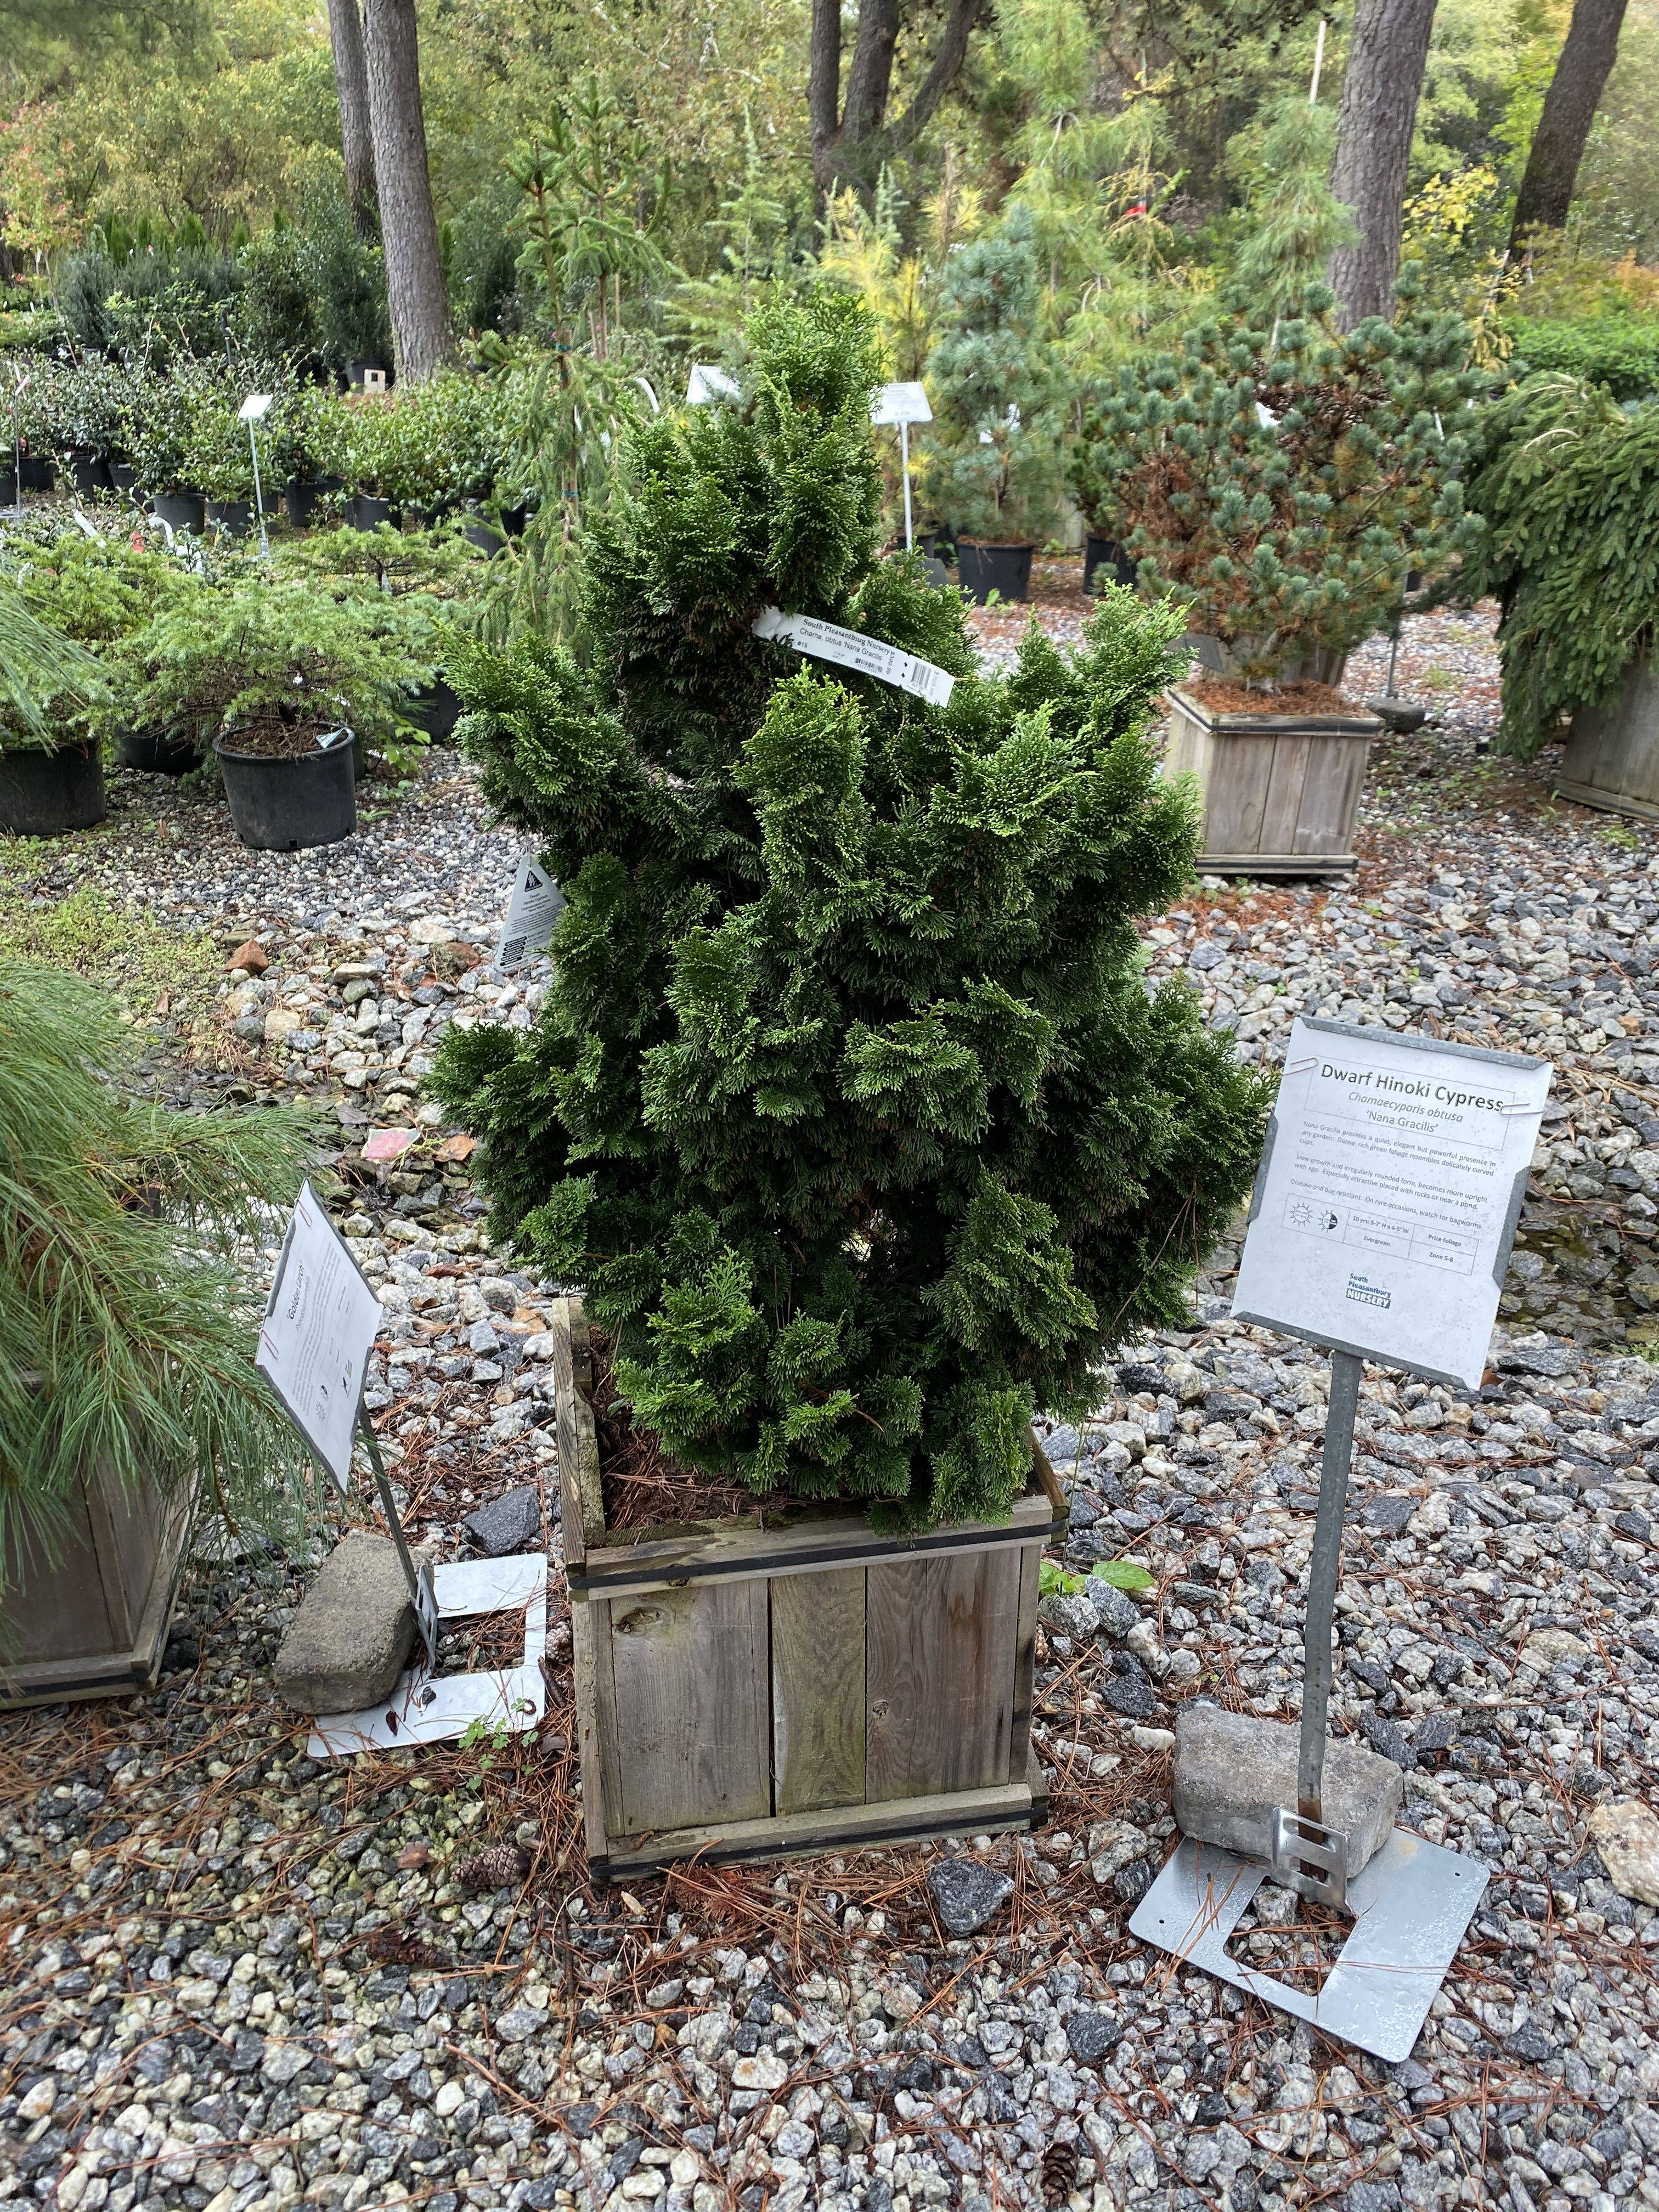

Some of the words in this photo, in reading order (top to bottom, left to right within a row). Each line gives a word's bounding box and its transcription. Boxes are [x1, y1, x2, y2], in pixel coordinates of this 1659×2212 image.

[803, 618, 823, 630] South
[825, 625, 866, 646] Pleasantburg
[867, 639, 890, 656] Nursery
[825, 636, 842, 646] obtus
[1321, 1064, 1373, 1085] Dwarf
[1375, 1074, 1430, 1097] Hinoki
[1435, 1086, 1503, 1111] Cypress
[1348, 1092, 1425, 1114] Chamaecyparis
[1427, 1108, 1463, 1122] obtusa
[1303, 1120, 1318, 1128] Nana
[1320, 1125, 1340, 1133] Gracilis
[1342, 1130, 1367, 1139] provides
[1393, 1141, 1415, 1150] elegant
[1429, 1149, 1457, 1159] powerful
[1459, 1155, 1487, 1165] presence
[1337, 1137, 1356, 1146] Dense,
[1389, 1148, 1408, 1158] foliage
[1409, 1154, 1440, 1164] resembles
[1441, 1160, 1471, 1171] delicately
[1472, 1167, 1494, 1176] curved
[1322, 1168, 1350, 1181] Especially
[1350, 1176, 1378, 1186] attractive
[1379, 1182, 1399, 1191] placed
[1344, 1166, 1373, 1177] irregularly
[1374, 1173, 1400, 1182] rounded
[1401, 1177, 1416, 1187] form,
[1418, 1181, 1445, 1193] becomes
[1465, 1193, 1487, 1203] upright
[1290, 1179, 1312, 1188] Disease
[1324, 1186, 1335, 1195] bug
[1336, 1190, 1362, 1200] resistant.
[1387, 1203, 1418, 1215] occasions,
[1449, 1217, 1481, 1228] bagworms
[1363, 1235, 1390, 1246] Evergreen
[1443, 1237, 1462, 1246] foliage
[1429, 1251, 1443, 1260] Zone
[1348, 1280, 1391, 1298] Pleasantburg
[1350, 1273, 1368, 1283] South
[1347, 1289, 1390, 1308] NURSERY
